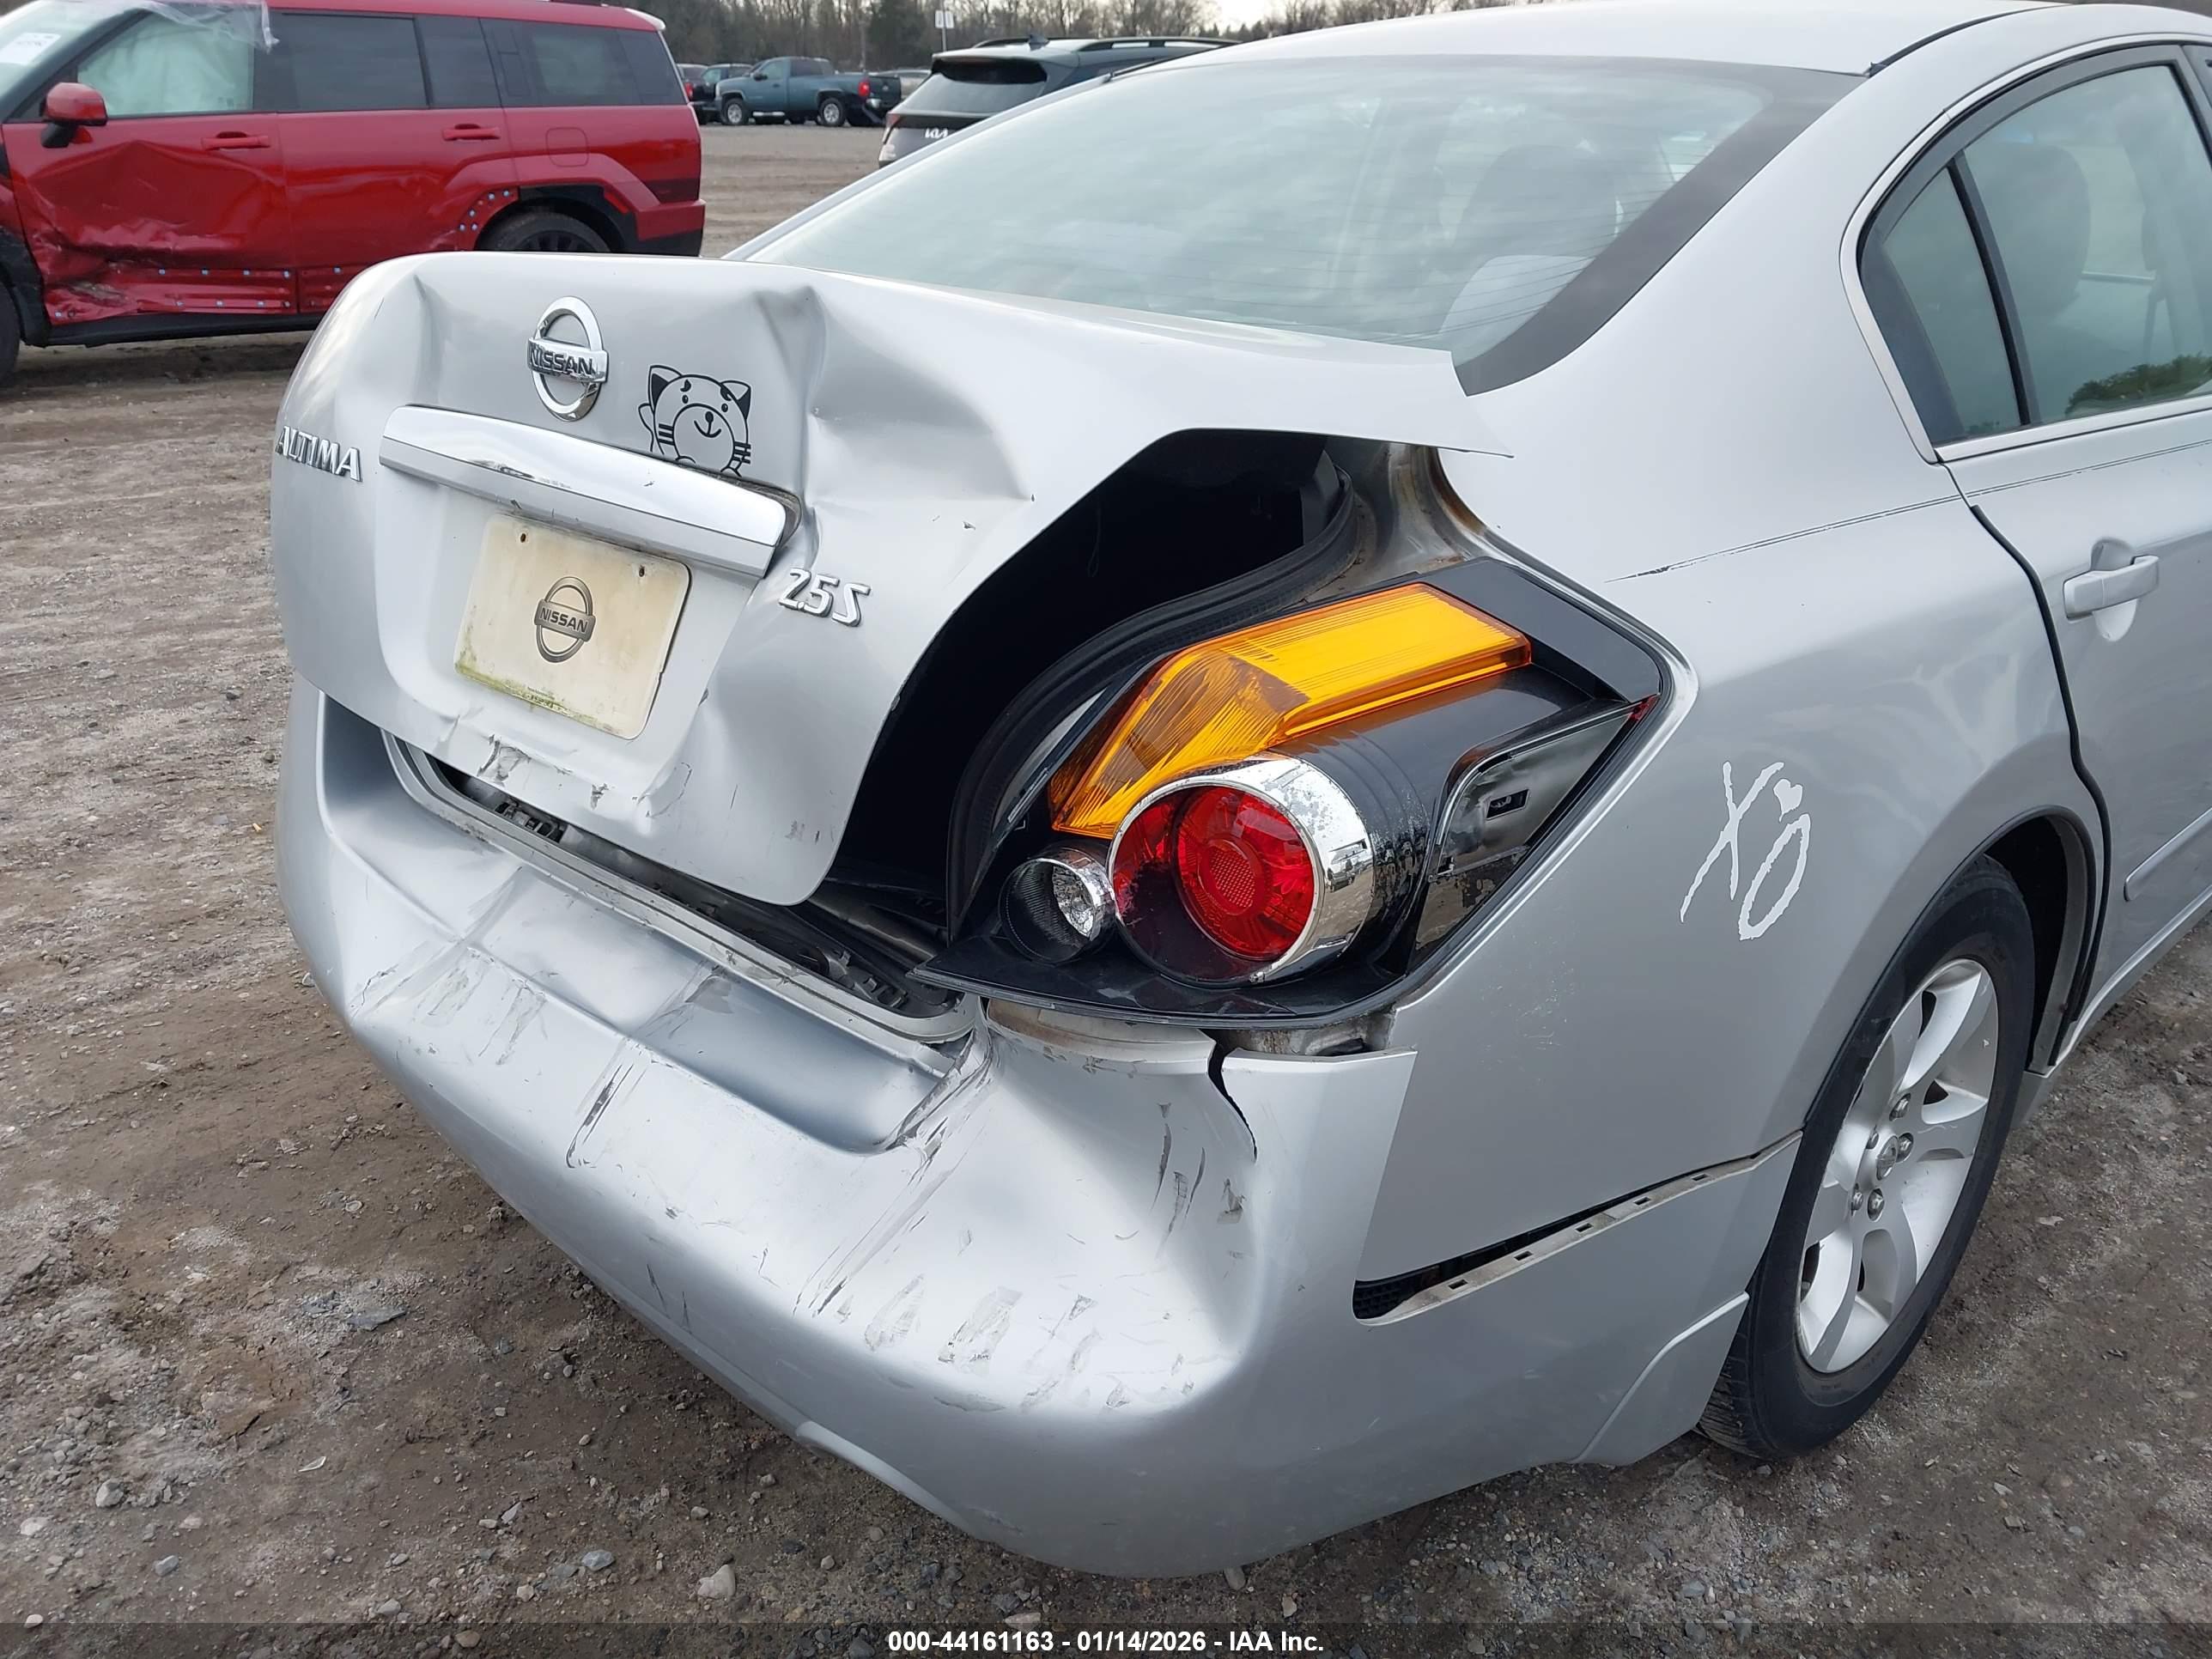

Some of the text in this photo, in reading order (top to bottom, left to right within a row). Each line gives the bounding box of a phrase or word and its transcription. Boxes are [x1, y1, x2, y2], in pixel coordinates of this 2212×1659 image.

[528, 342, 596, 378] NISSAN
[275, 425, 363, 483] ALTIMA
[539, 606, 588, 633] NISSAN
